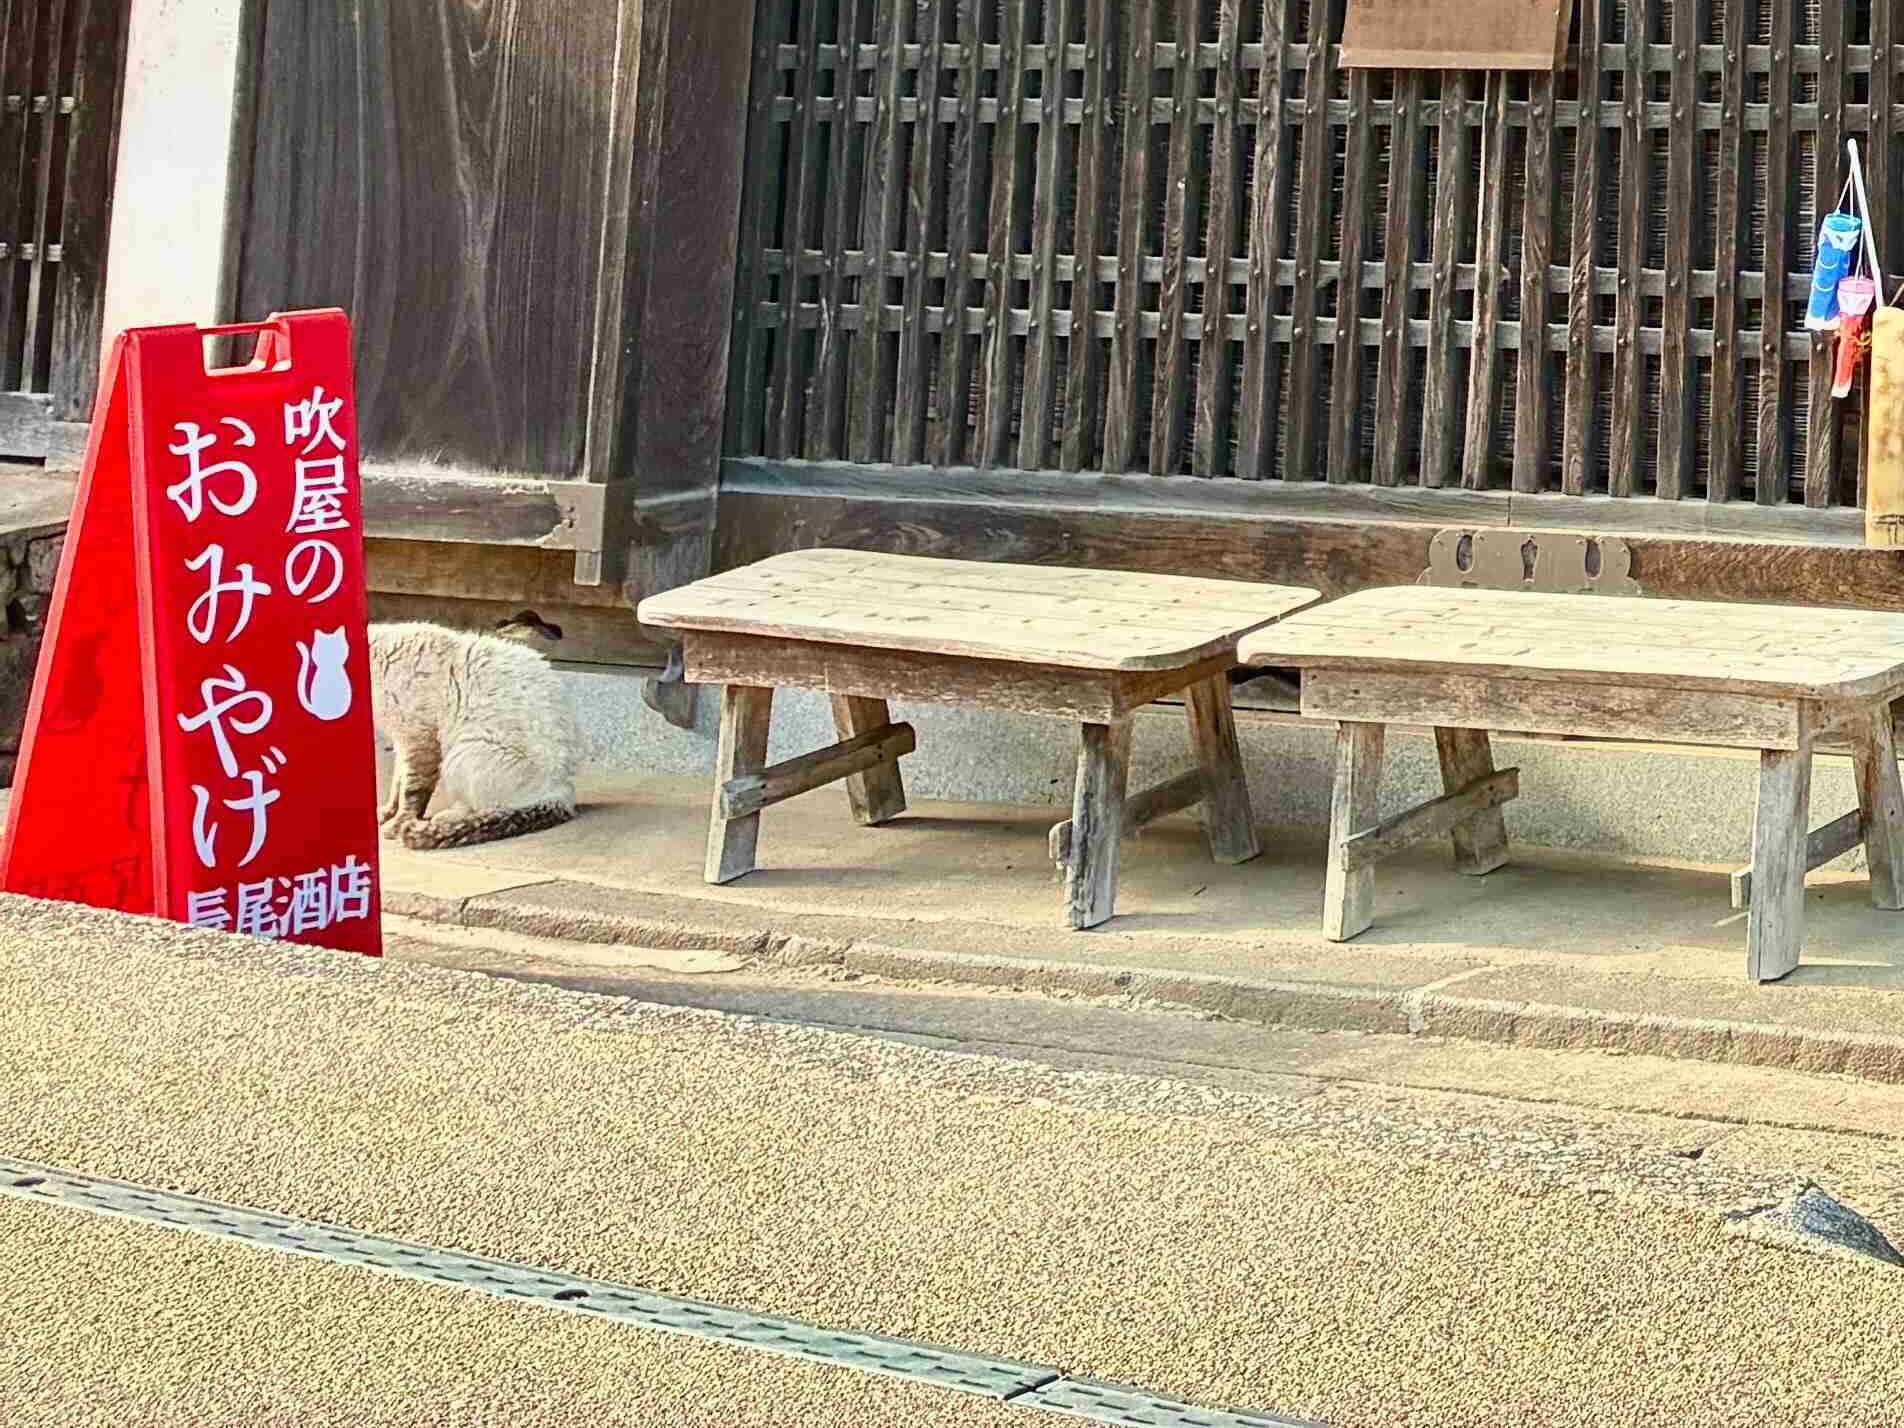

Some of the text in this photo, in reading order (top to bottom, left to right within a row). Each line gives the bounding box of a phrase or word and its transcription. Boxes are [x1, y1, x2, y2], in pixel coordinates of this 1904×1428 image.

[166, 418, 288, 868] おみやげ
[284, 386, 349, 604] 吹屋の
